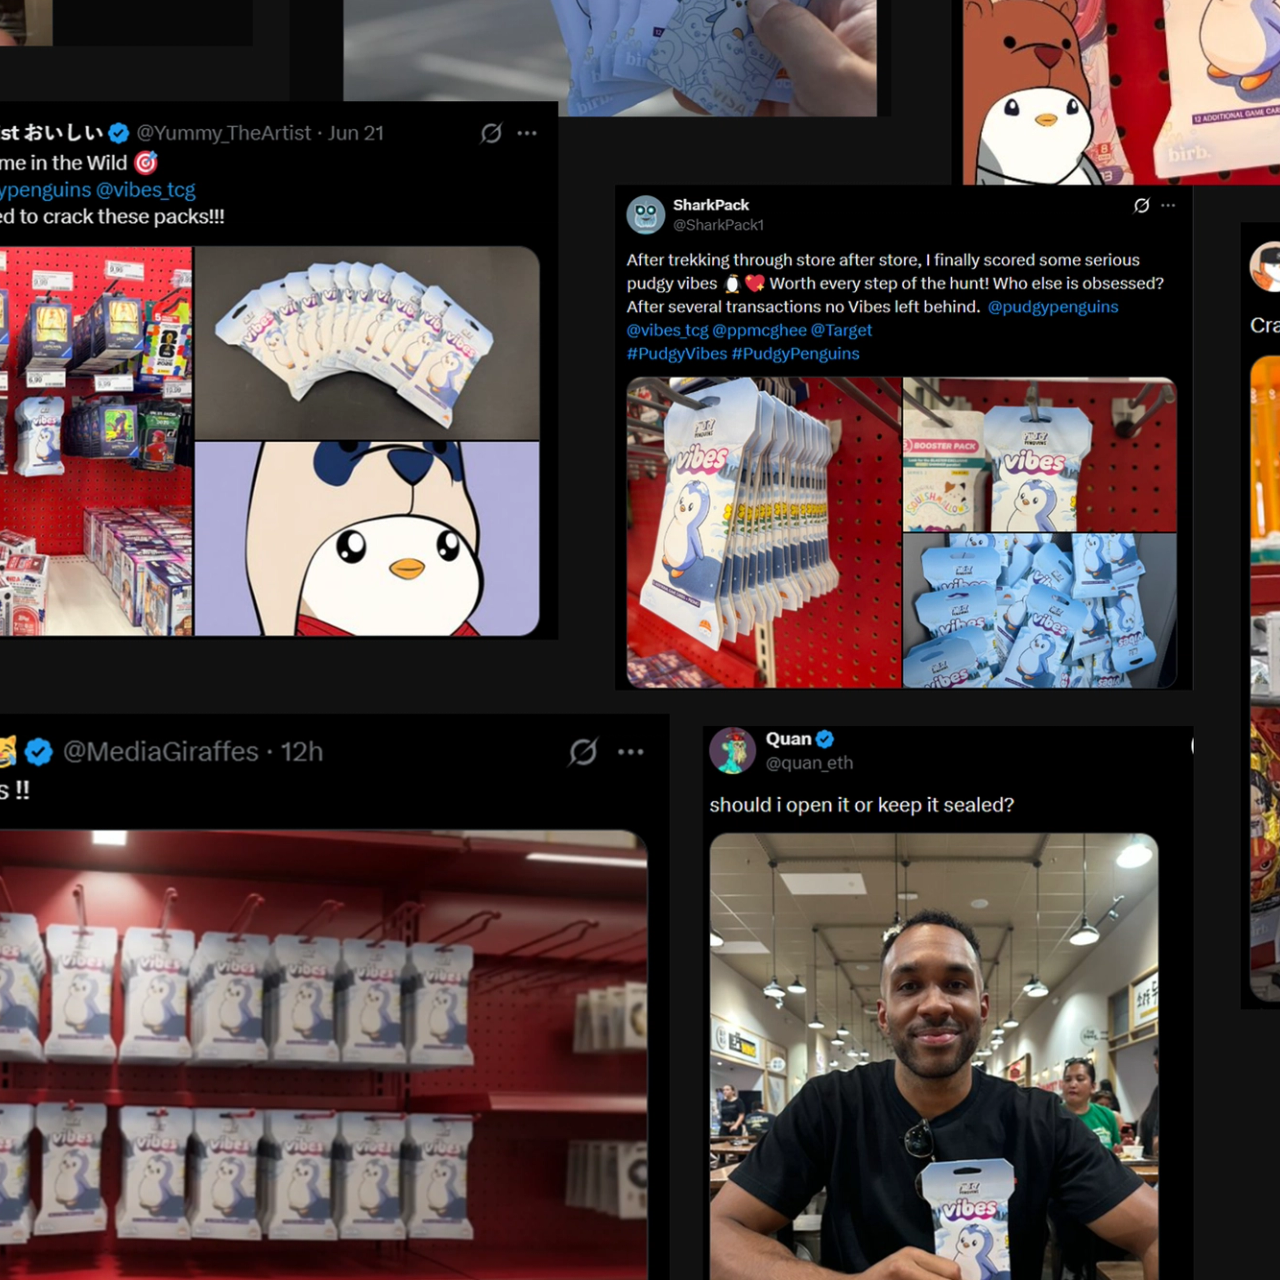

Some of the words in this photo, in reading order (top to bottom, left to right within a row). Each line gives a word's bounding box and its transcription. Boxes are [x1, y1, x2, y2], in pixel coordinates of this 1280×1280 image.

[24, 124, 103, 141] おいしい
[674, 199, 749, 210] SharkPack
[627, 347, 727, 363] #PudgyVibes
[732, 347, 859, 363] #PudgyPenguins
[913, 441, 951, 450] BOOSTER
[954, 441, 976, 450] PACK
[1004, 448, 1066, 476] vibes
[766, 732, 811, 748] Quan
